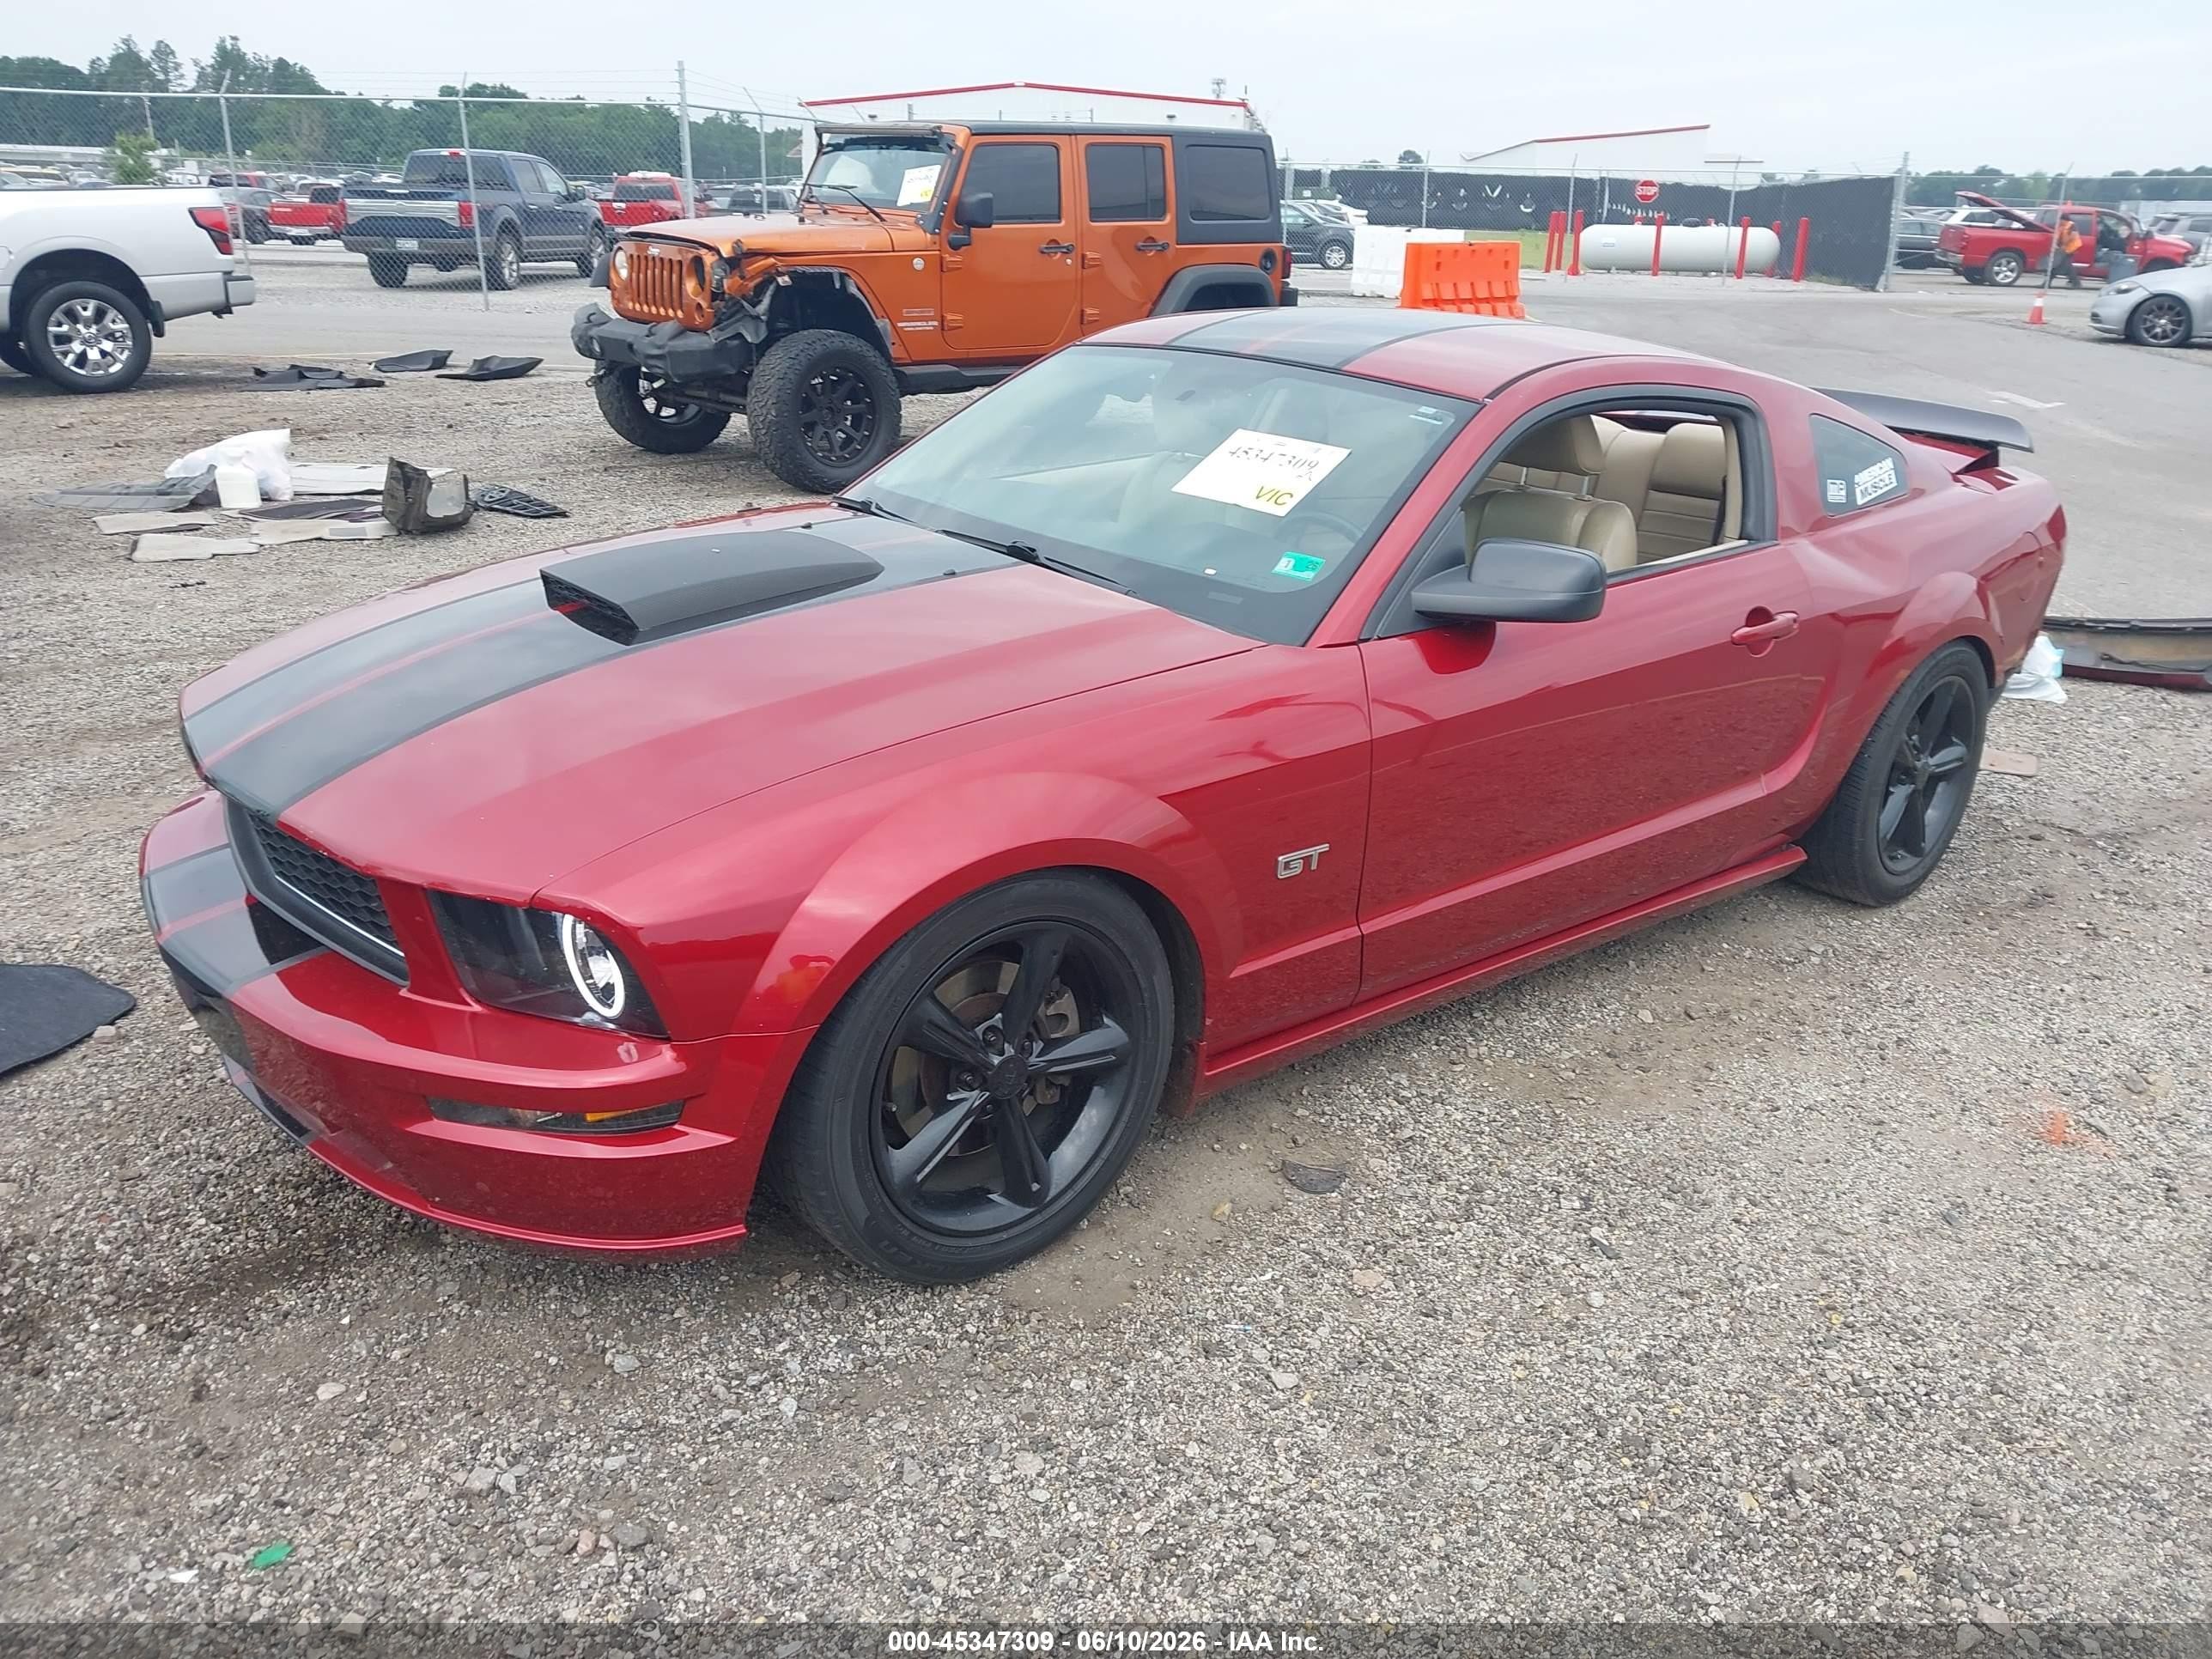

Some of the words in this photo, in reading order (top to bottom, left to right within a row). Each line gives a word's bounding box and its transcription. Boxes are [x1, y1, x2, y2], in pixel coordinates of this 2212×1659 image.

[1636, 185, 1656, 195] STOP
[1255, 486, 1294, 506] VIC
[1859, 473, 1894, 501] MUSCLE
[1278, 843, 1330, 879] GT
